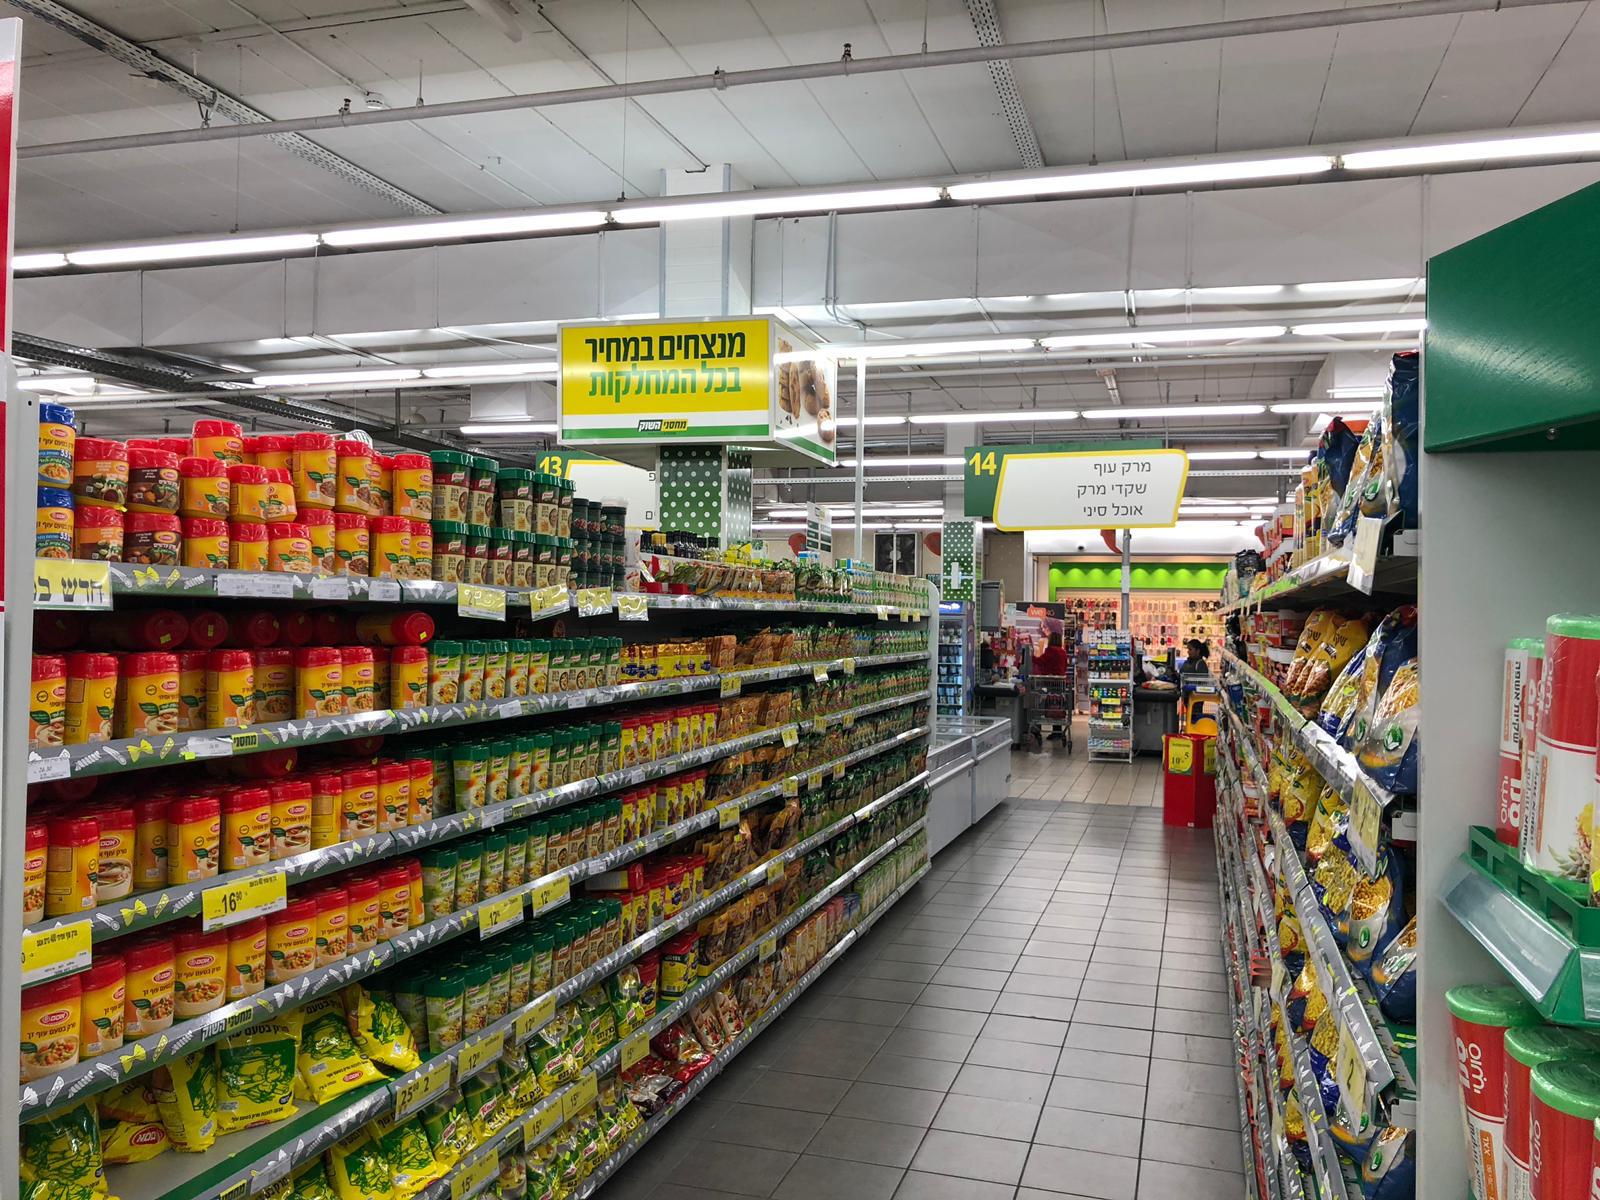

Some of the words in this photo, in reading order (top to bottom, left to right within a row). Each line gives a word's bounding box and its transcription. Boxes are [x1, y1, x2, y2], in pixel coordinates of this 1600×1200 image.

[585, 335, 655, 363] במחיר
[659, 331, 746, 361] מנצחים
[588, 361, 697, 403] המחלקות
[700, 360, 742, 393] בכל
[638, 420, 662, 432] השוק
[664, 420, 687, 430] מחסני
[539, 456, 563, 477] 13
[969, 451, 997, 476] 14
[1093, 462, 1117, 476] עוף
[1121, 461, 1151, 475] מרק
[1077, 484, 1106, 498] מרק
[1111, 482, 1147, 496] שקדי
[1083, 505, 1108, 517] סיני
[1112, 502, 1143, 516] אוכל
[61, 577, 103, 603] חדש
[1513, 660, 1521, 701] אשפה
[222, 892, 237, 914] 16
[36, 1030, 48, 1039] עוף
[202, 1019, 226, 1042] השוק
[244, 1024, 272, 1036] בטעם
[401, 1086, 413, 1106] 25
